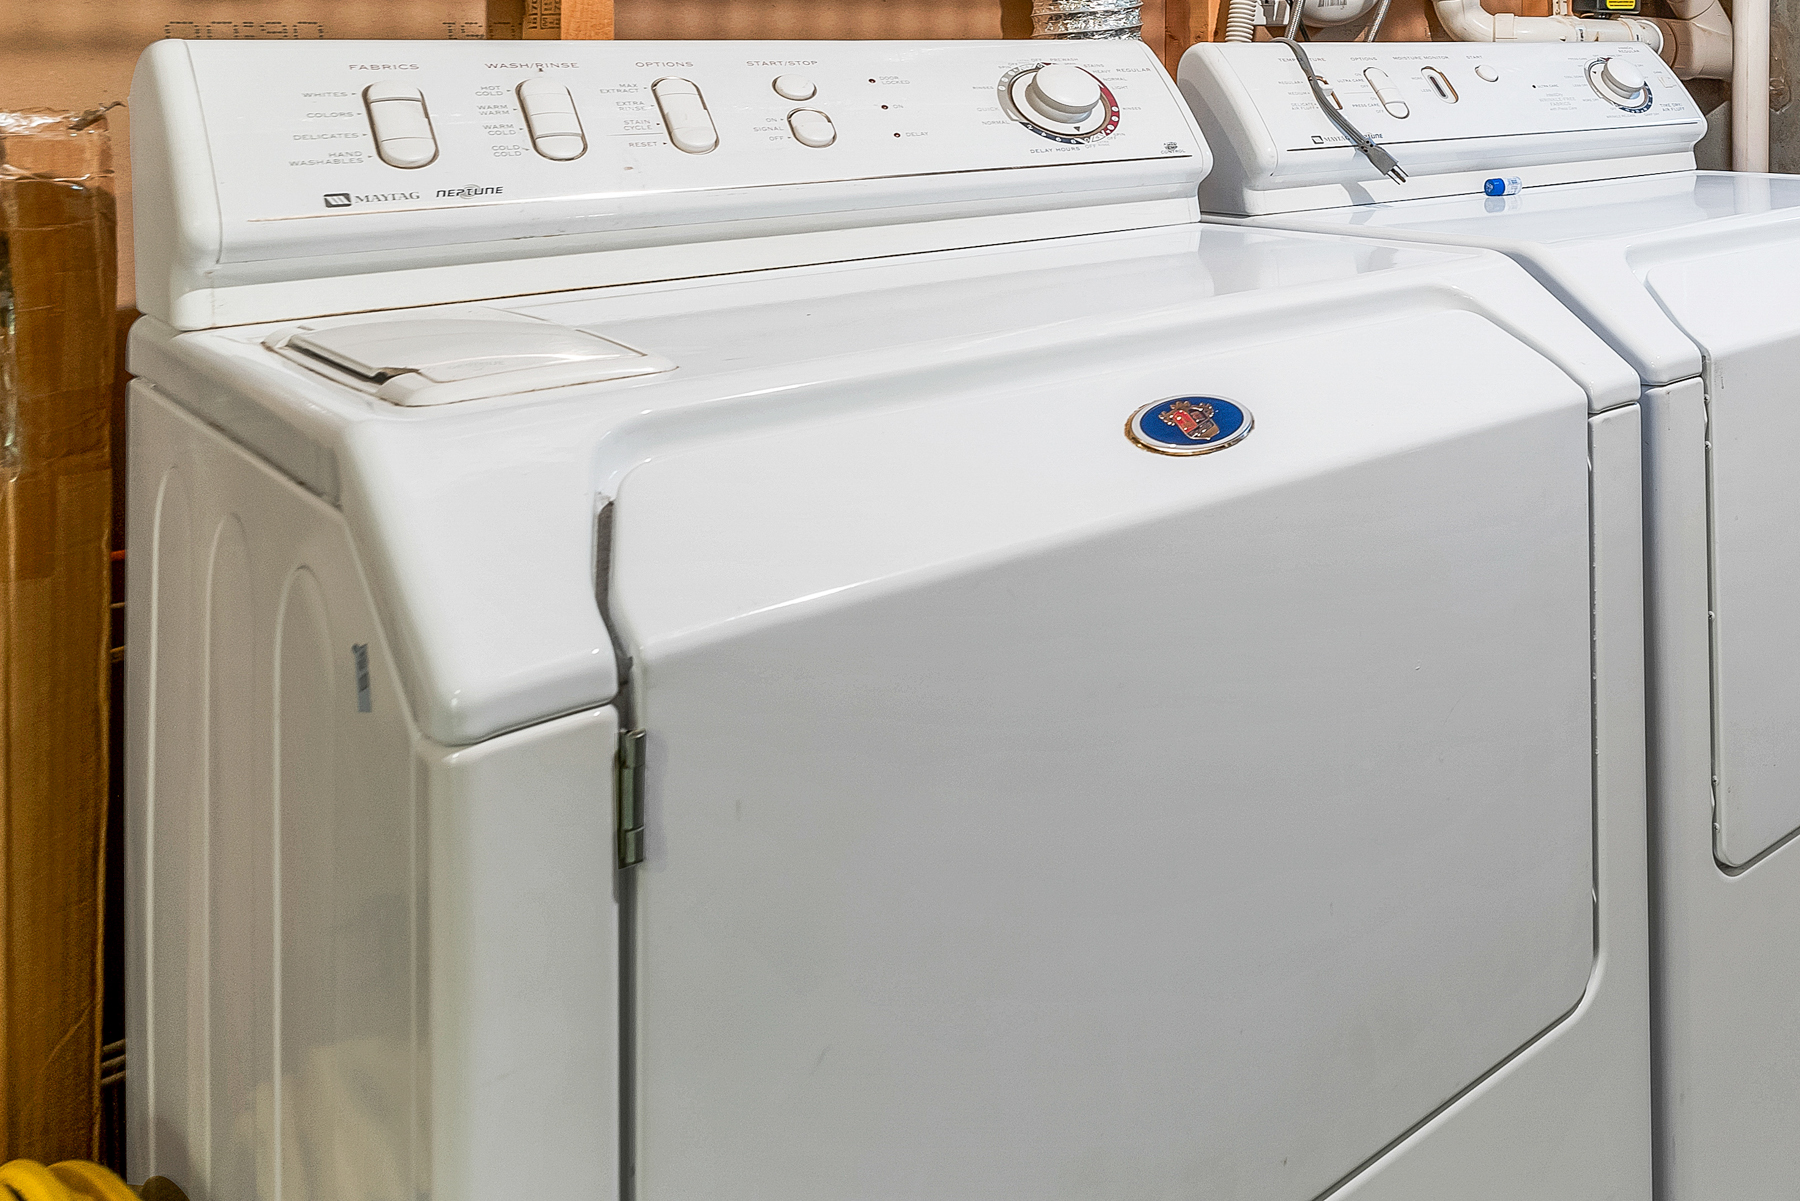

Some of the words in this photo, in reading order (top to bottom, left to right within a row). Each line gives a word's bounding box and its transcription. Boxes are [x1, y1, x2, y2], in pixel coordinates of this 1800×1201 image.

[348, 63, 420, 71] FABRICS
[306, 111, 354, 119] COLORS
[292, 132, 359, 141] DELICATES
[288, 157, 364, 167] WASHABLES
[436, 186, 504, 198] NEPTUNE
[354, 191, 420, 203] MAYTAG
